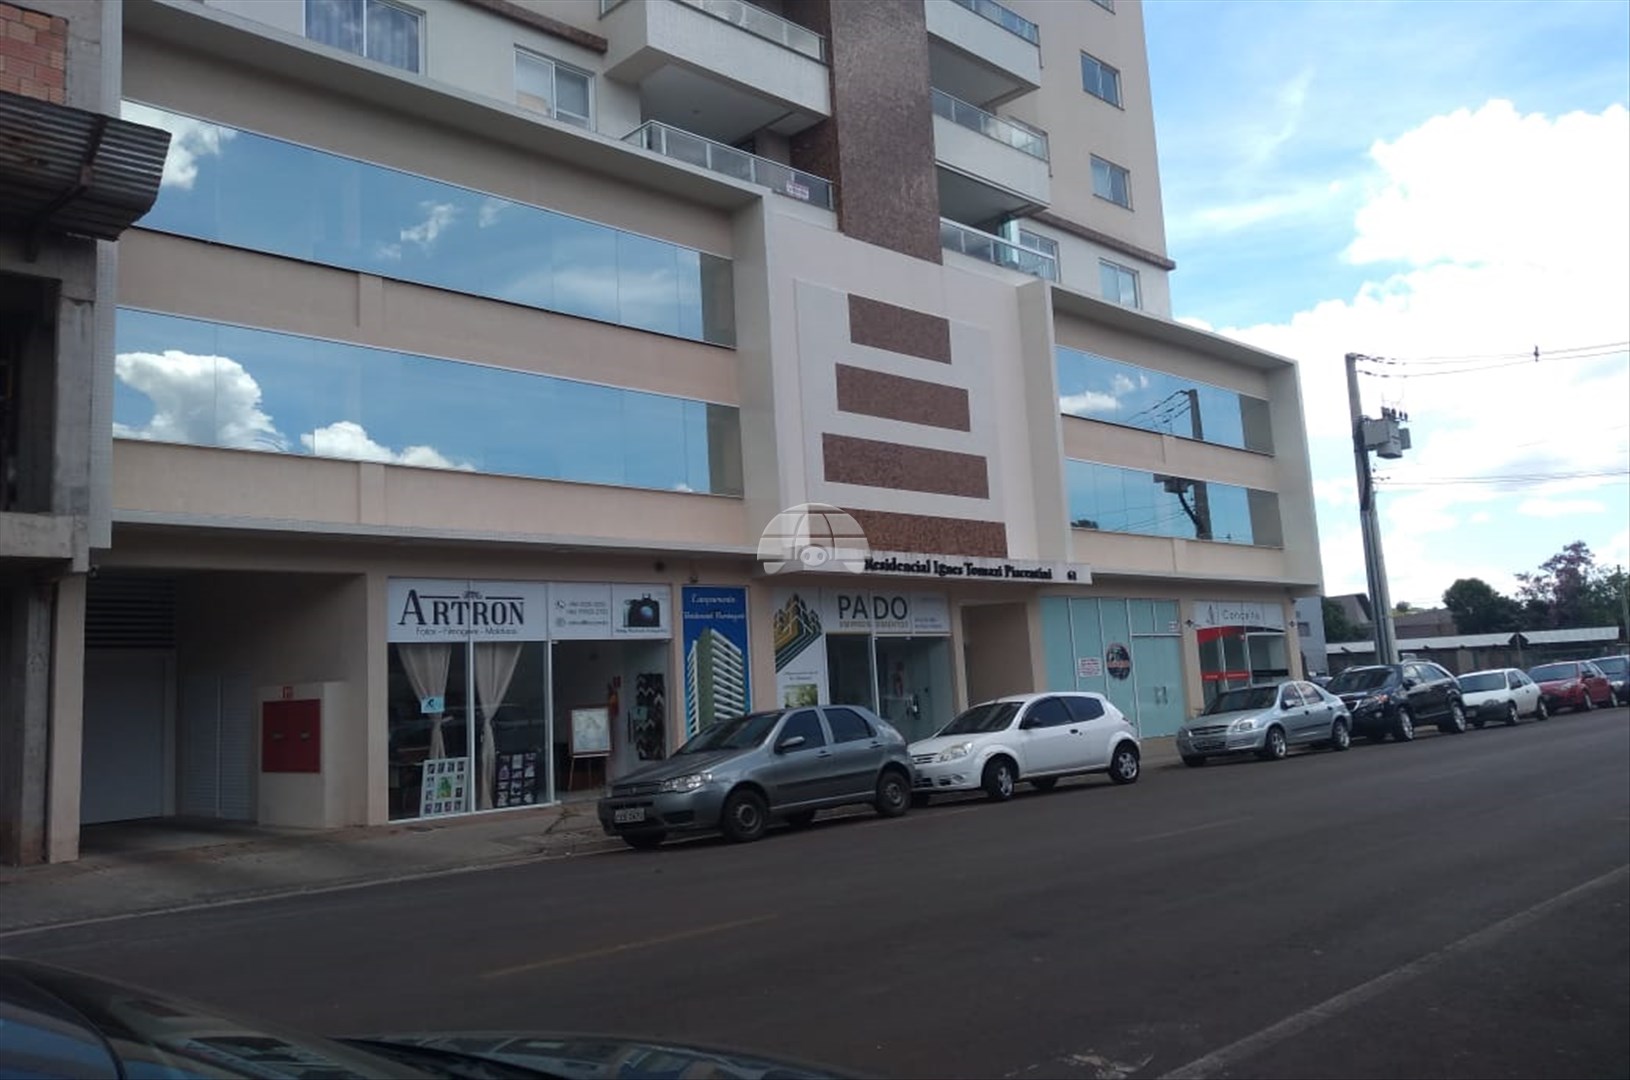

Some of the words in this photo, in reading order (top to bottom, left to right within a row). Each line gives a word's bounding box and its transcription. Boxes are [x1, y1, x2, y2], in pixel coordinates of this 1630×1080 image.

[864, 557, 931, 573] Residencial
[397, 589, 525, 626] ARTRON
[837, 595, 908, 620] PADO
